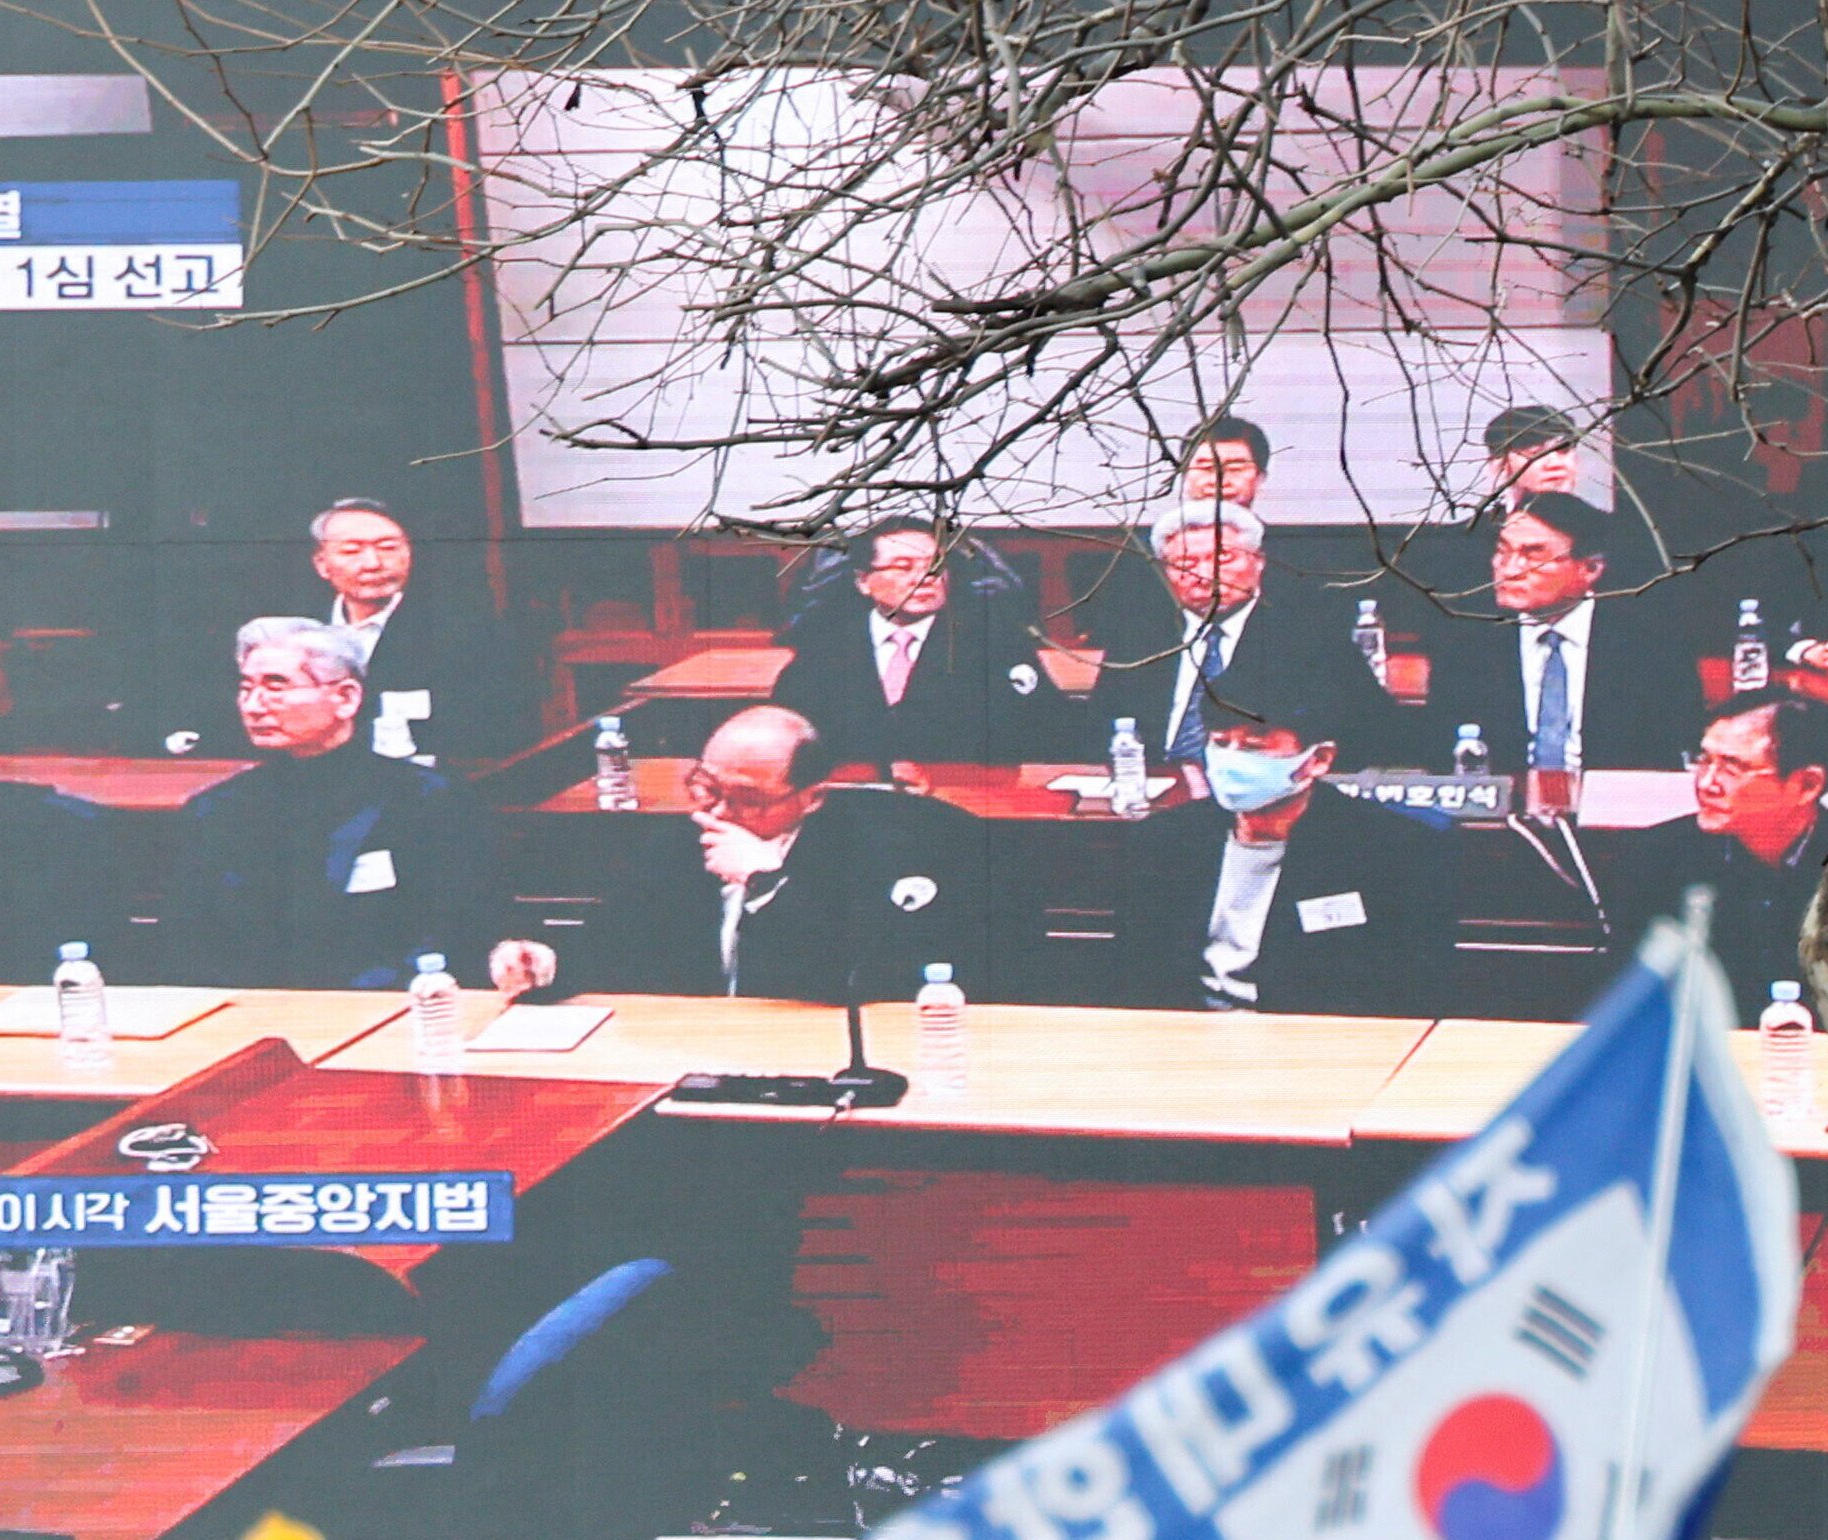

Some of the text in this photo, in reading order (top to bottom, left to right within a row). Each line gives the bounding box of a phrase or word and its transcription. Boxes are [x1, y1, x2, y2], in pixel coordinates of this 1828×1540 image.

[16, 254, 95, 301] 1심
[113, 253, 219, 299] 선고
[145, 1180, 489, 1236] 서울중앙지법
